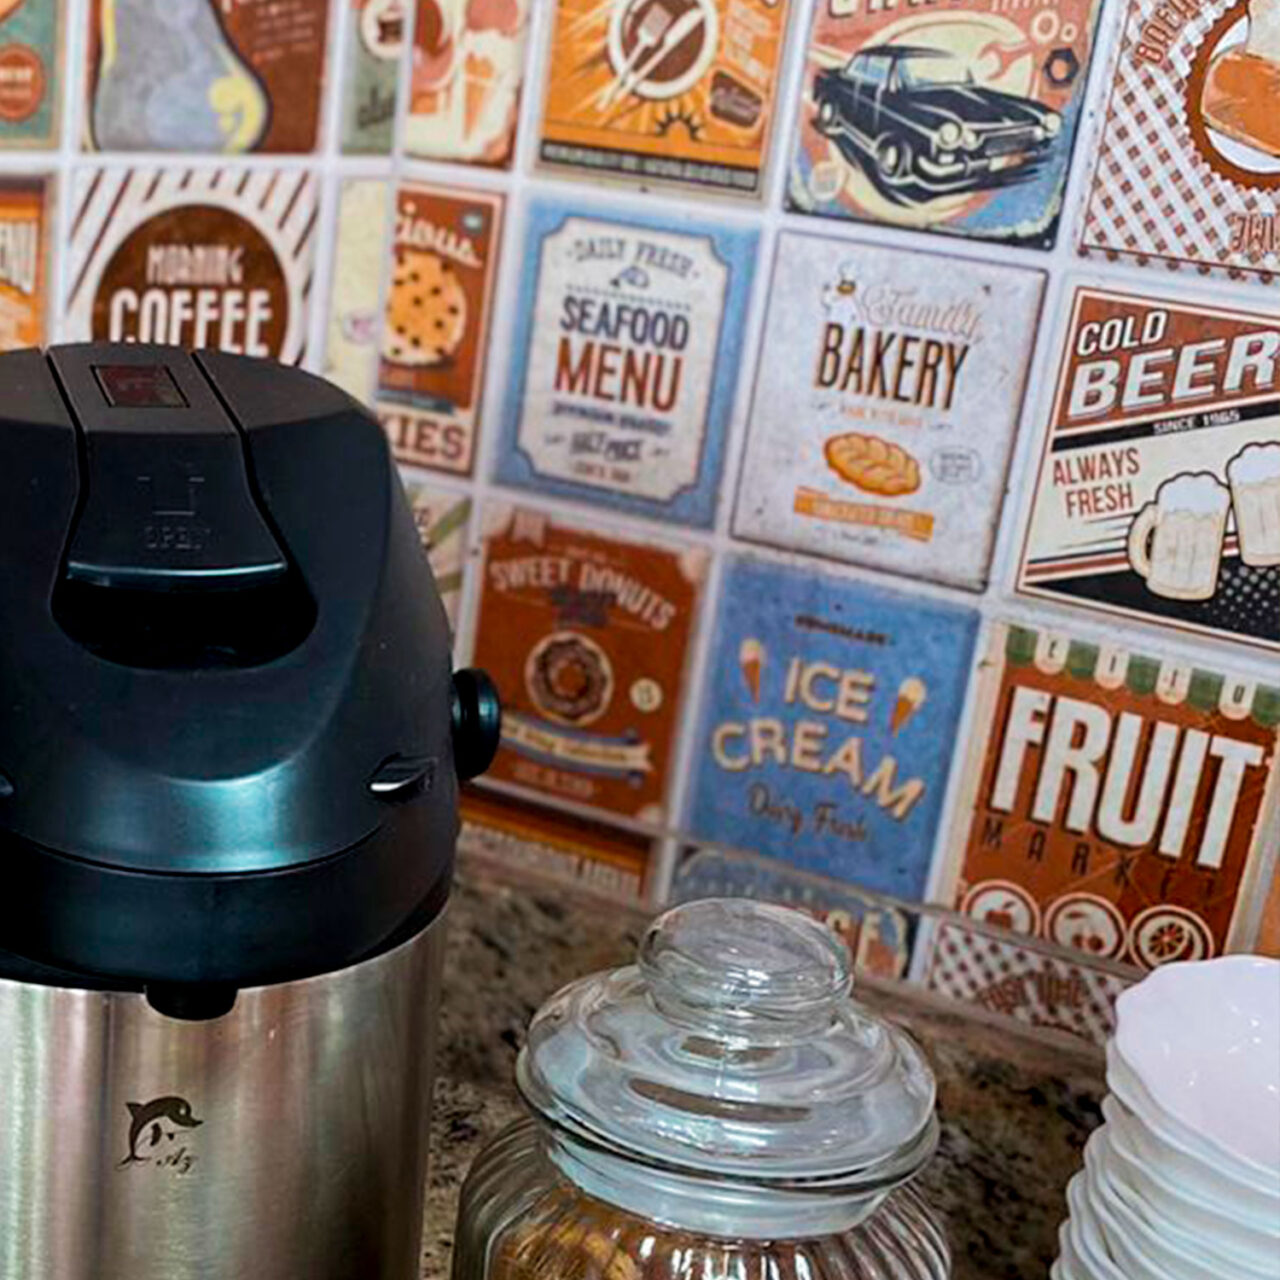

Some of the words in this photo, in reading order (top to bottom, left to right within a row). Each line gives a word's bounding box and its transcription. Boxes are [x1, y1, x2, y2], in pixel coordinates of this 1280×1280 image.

[395, 202, 483, 268] ious
[109, 288, 273, 358] COFFEE
[560, 296, 690, 351] SEAFOOD
[1077, 310, 1168, 357] COLD
[553, 335, 683, 413] MENU
[816, 321, 971, 412] BAKERY
[1067, 329, 1280, 419] BEER
[384, 412, 466, 461] IES
[1153, 415, 1195, 436] SINCE
[1053, 448, 1140, 487] ALWAYS
[1065, 481, 1135, 519] FRESH
[489, 556, 570, 591] SWEET
[578, 562, 677, 631] DONUTS
[785, 656, 876, 723] ICE
[711, 717, 927, 823] CREAM
[990, 684, 1266, 870] FRUIT
